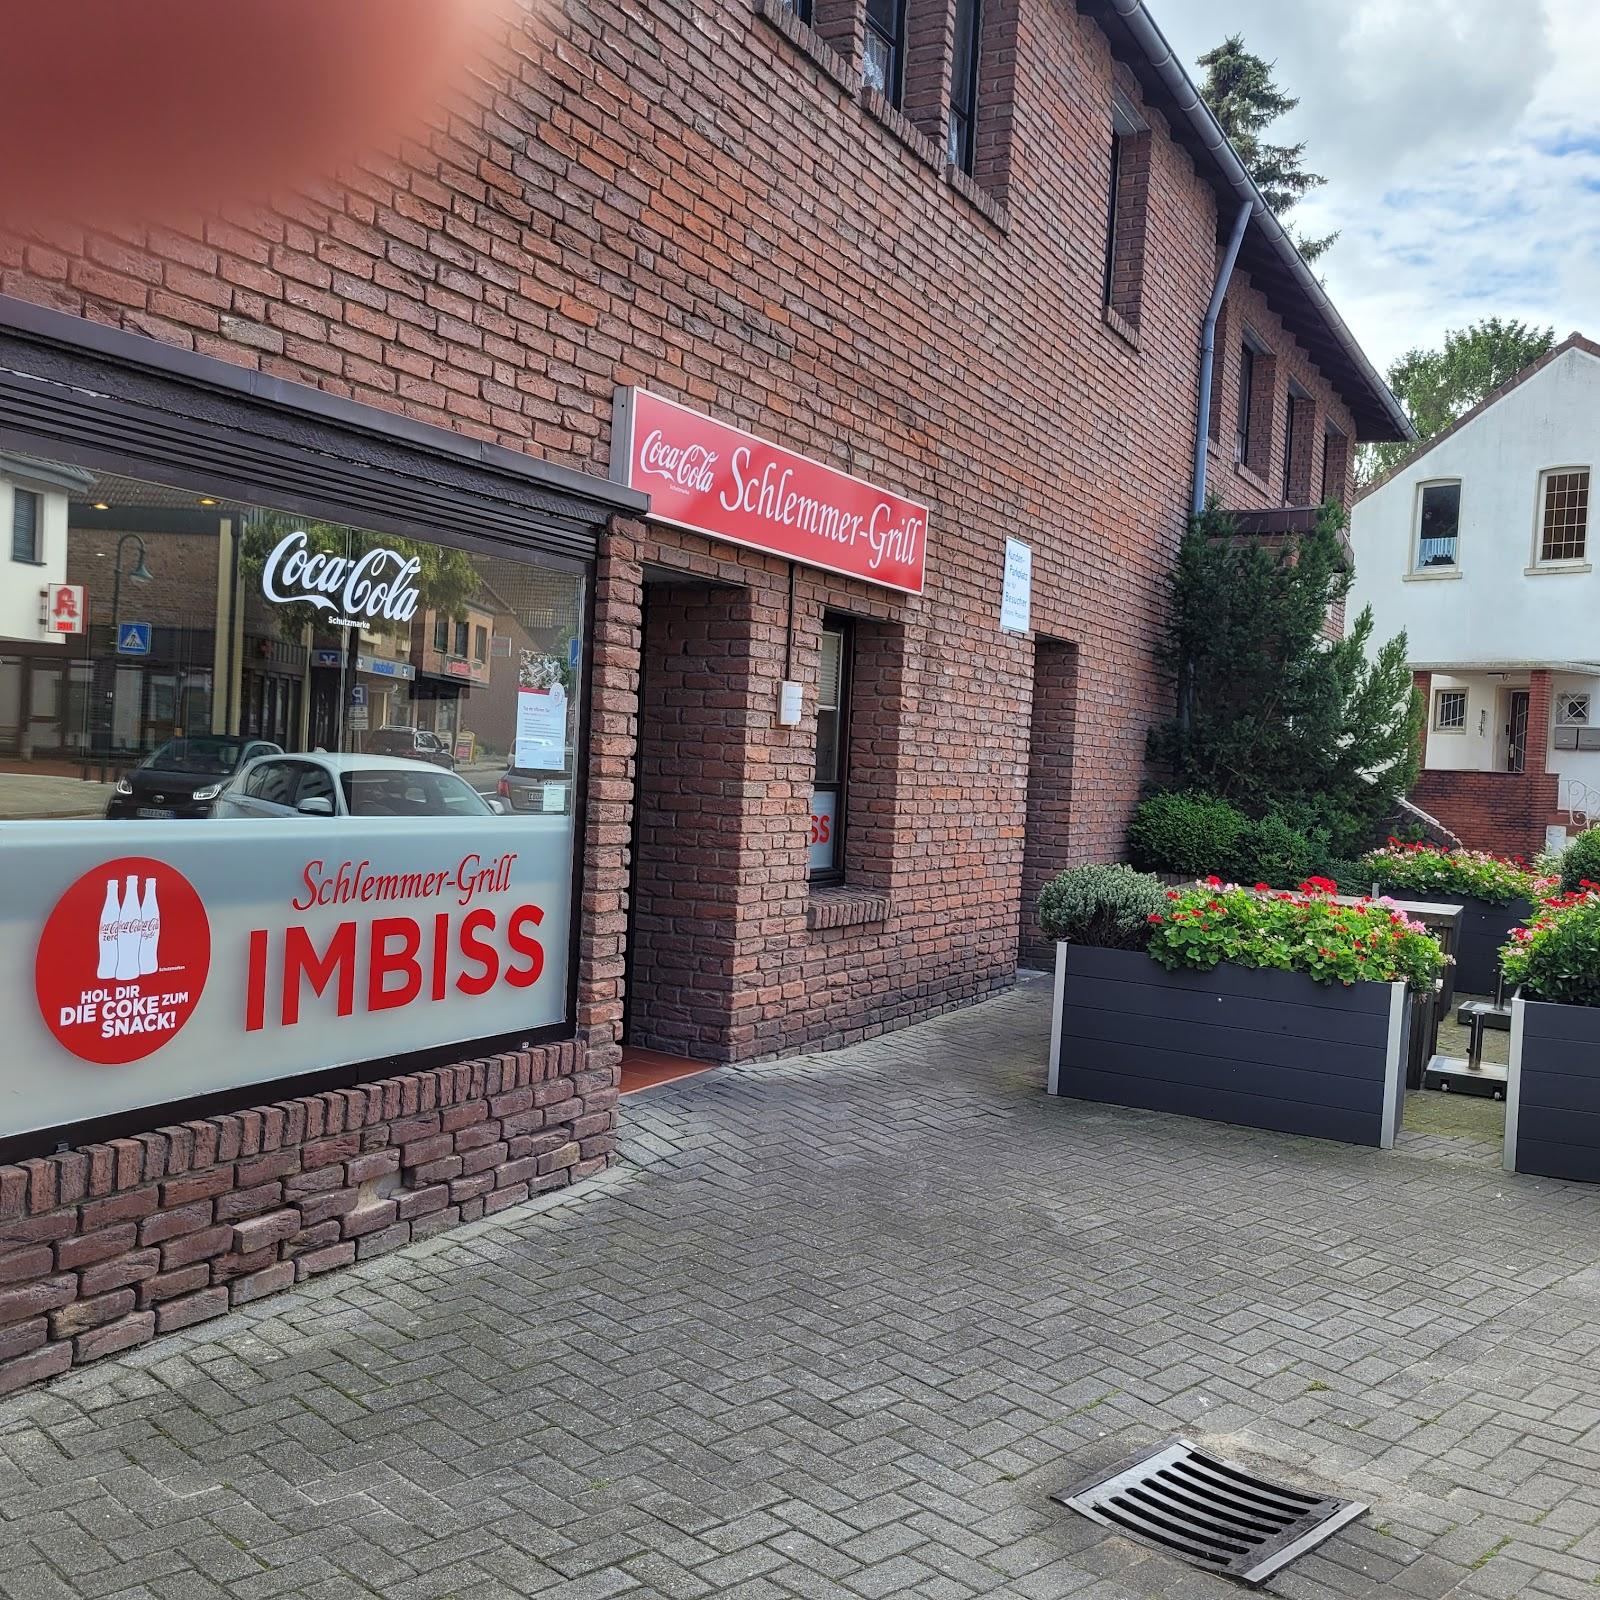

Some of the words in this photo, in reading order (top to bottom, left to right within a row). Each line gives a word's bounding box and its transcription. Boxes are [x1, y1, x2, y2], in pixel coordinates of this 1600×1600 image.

[640, 429, 719, 493] Coca-Cola
[719, 446, 922, 569] Schlemmer-Grill
[262, 531, 421, 622] Coca-Cola
[327, 615, 371, 630] Schutzmarke
[292, 854, 518, 911] Schlemmer-Grill
[81, 988, 112, 1004] HOL
[115, 985, 140, 1000] DIR
[245, 904, 545, 1032] IMBISS
[60, 1004, 97, 1026] DIE
[102, 996, 159, 1020] COKE
[161, 991, 188, 1006] ZUM
[101, 1011, 176, 1038] SNACK!
